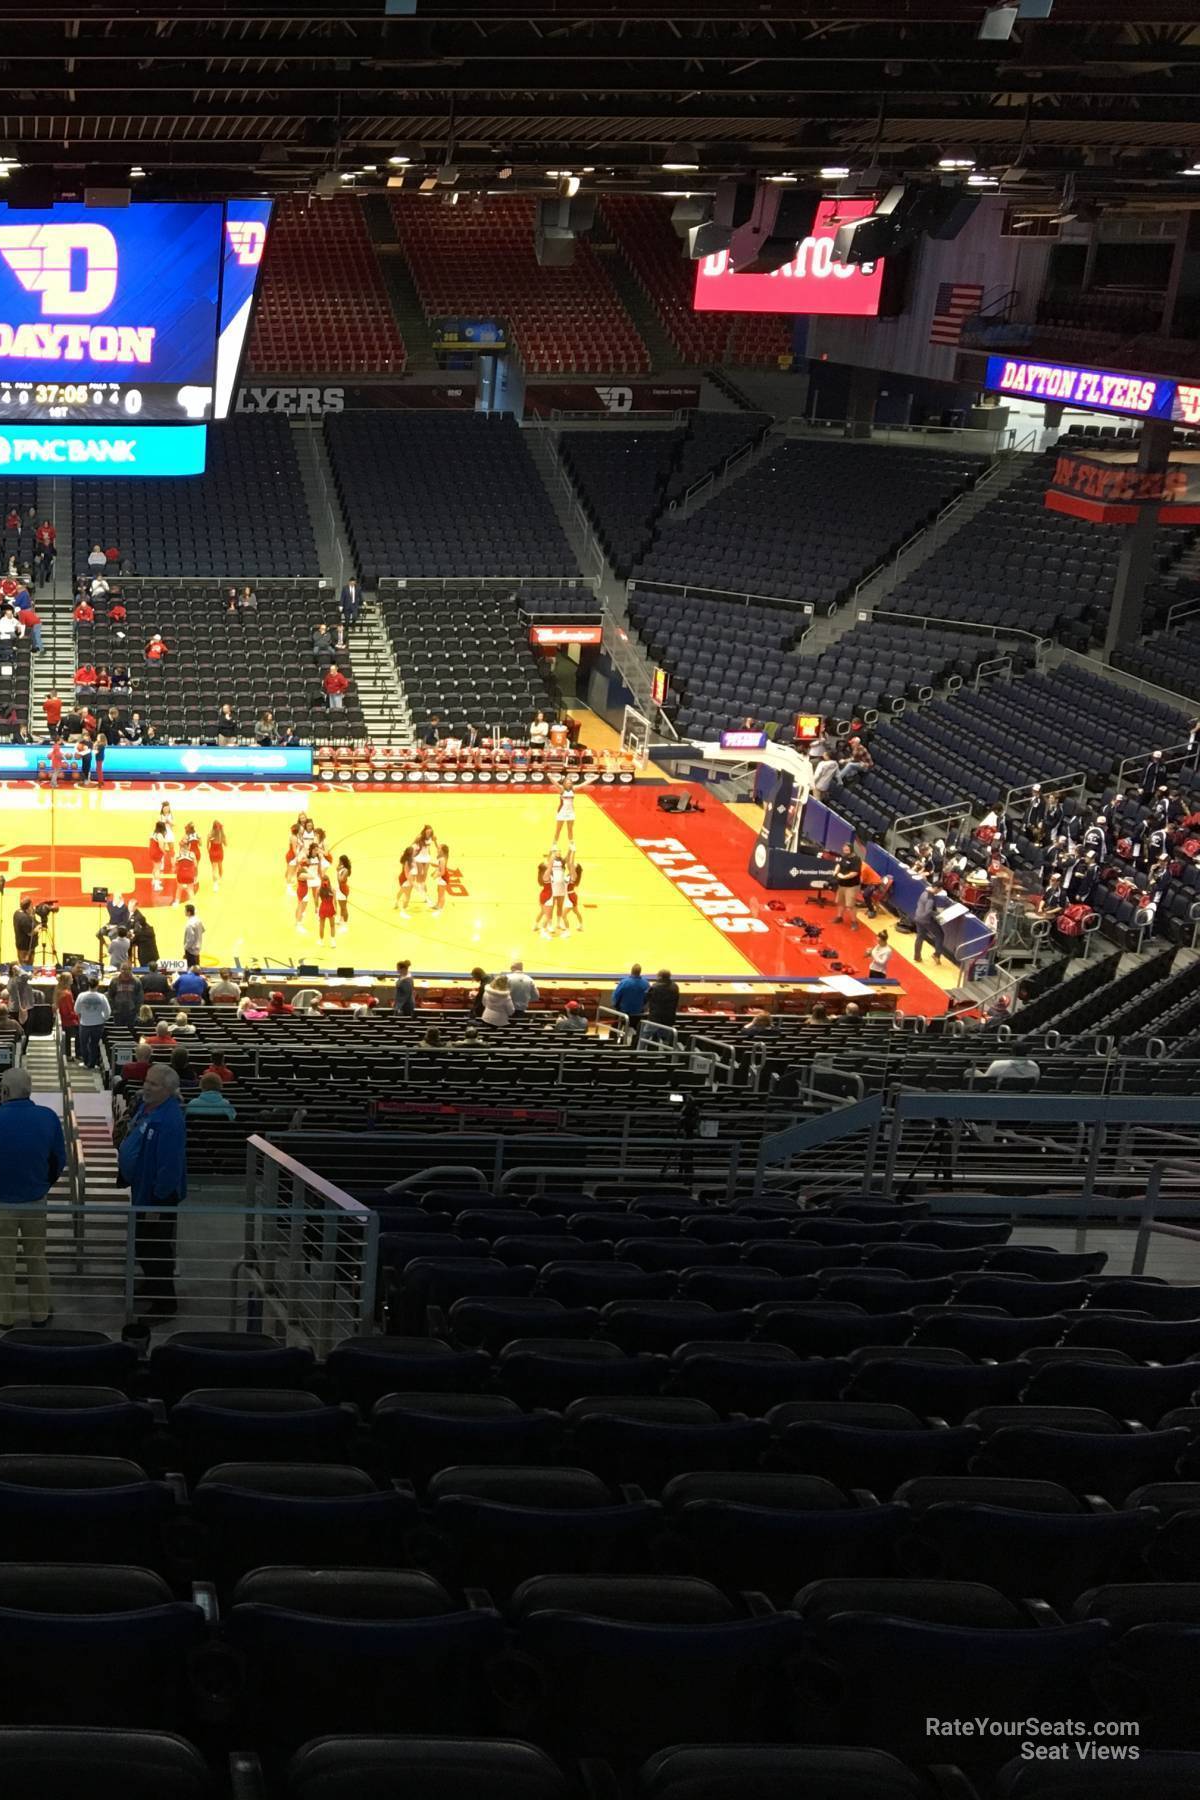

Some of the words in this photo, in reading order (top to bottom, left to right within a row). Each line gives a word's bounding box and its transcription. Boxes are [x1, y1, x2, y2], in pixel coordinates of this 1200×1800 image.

[28, 223, 118, 314] D
[1, 391, 11, 404] 4
[19, 391, 29, 405] 0
[93, 391, 103, 405] 0
[109, 391, 119, 405] 4
[1001, 361, 1078, 399] DAYTON
[1074, 371, 1157, 412] FLYERS
[125, 389, 142, 414] 0
[234, 388, 345, 414] LYERS
[151, 781, 357, 793] DAYTON
[634, 837, 770, 933] FLYERS
[160, 960, 185, 969] WHIO
